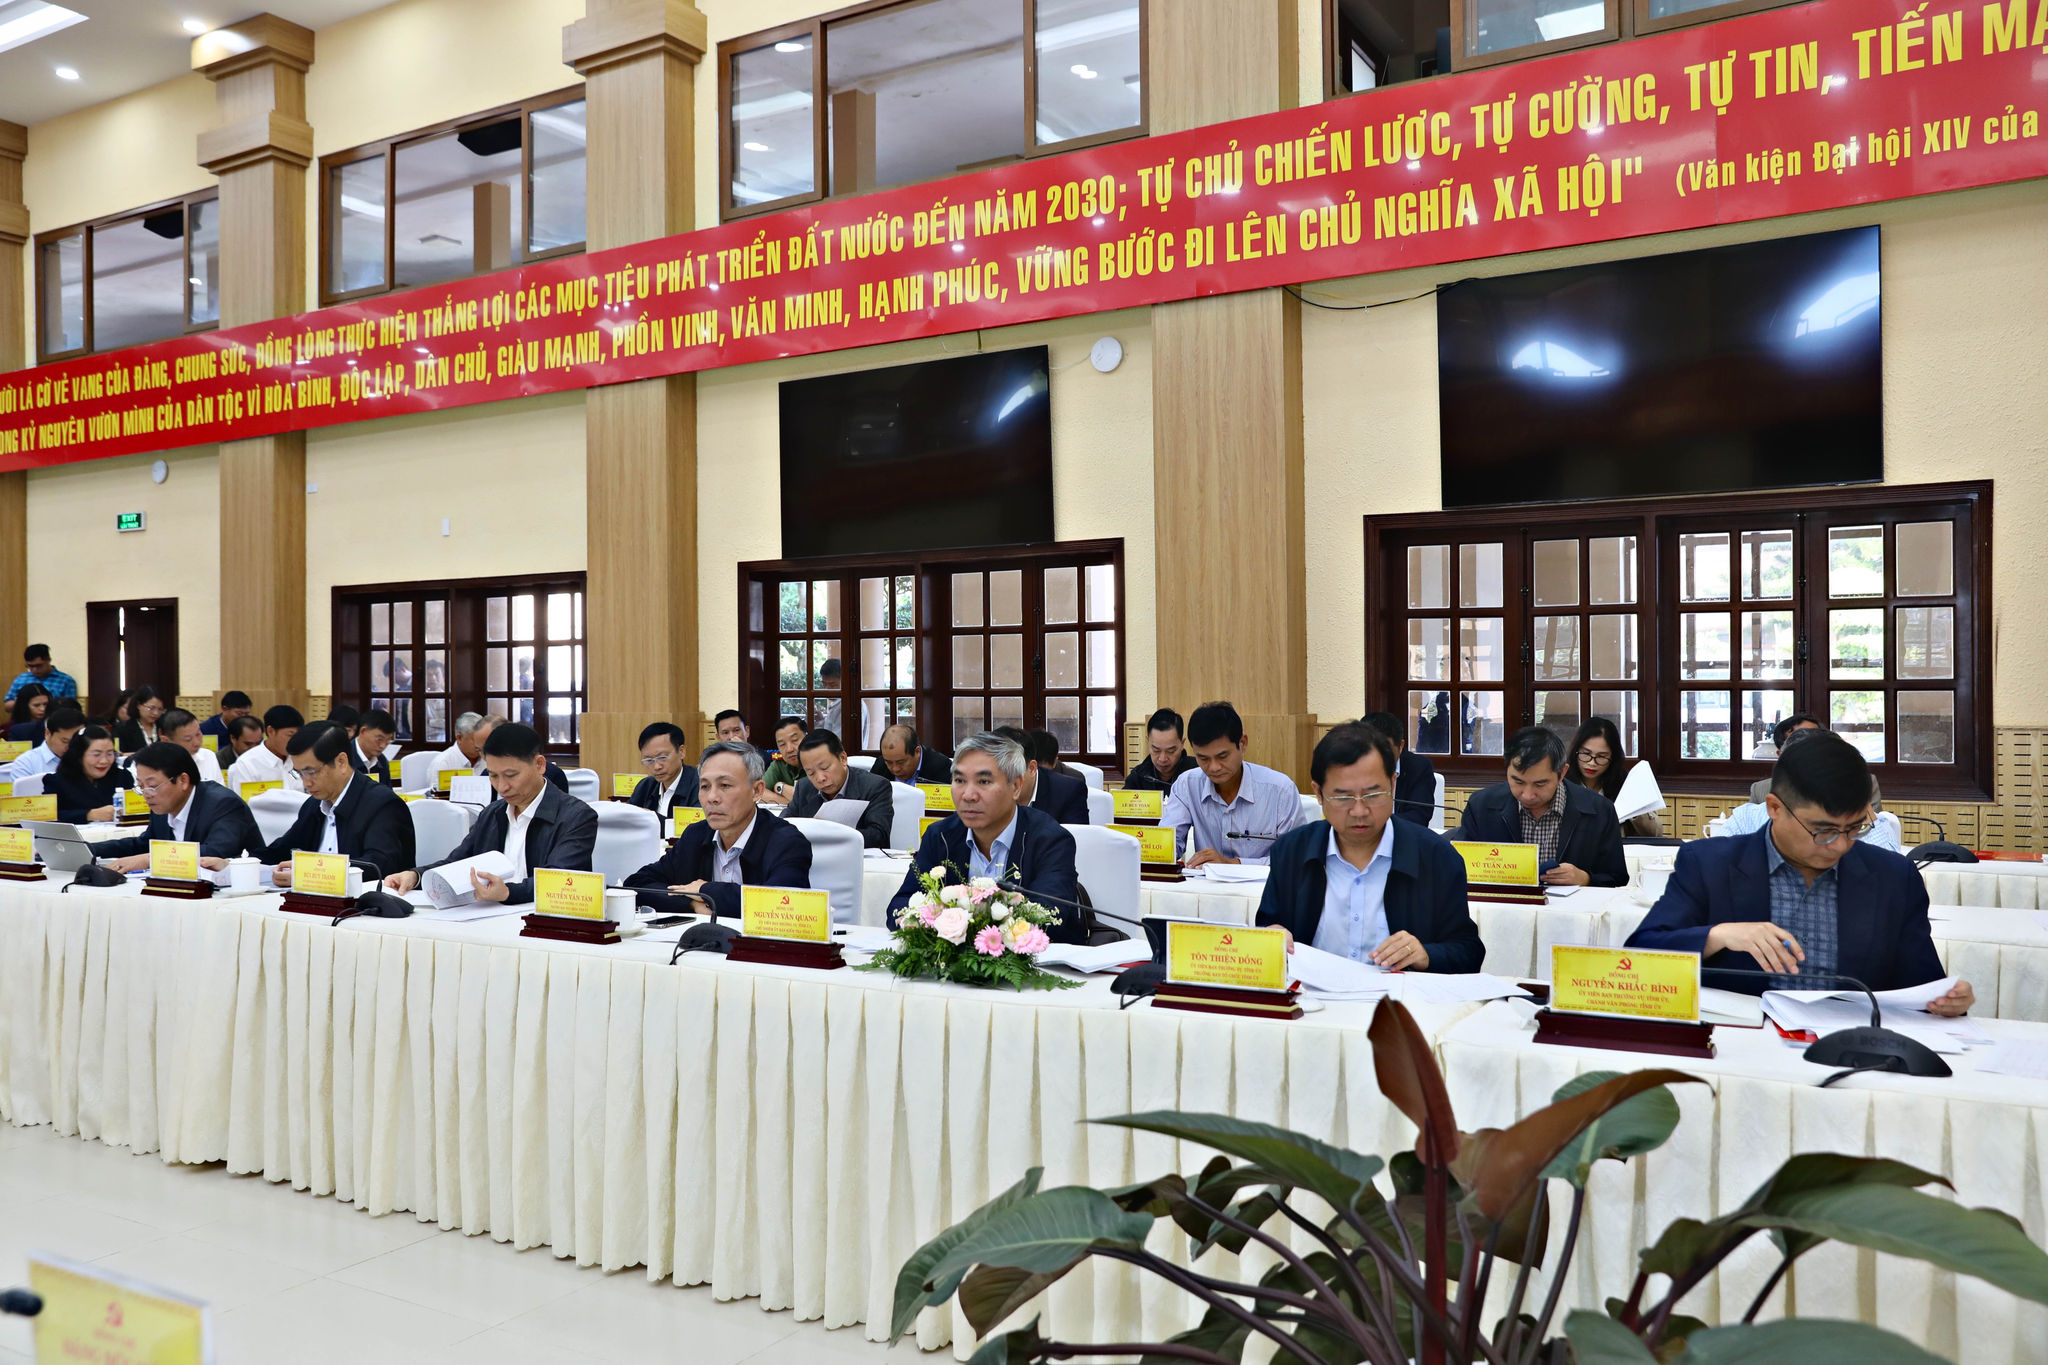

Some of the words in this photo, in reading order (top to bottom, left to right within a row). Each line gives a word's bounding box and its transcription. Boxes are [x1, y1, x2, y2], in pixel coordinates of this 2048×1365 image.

[1676, 160, 1735, 196] (Văn
[1746, 148, 1801, 184] kiện
[1869, 127, 1911, 166] hội
[1924, 116, 1971, 154] XIV
[1984, 105, 2038, 144] của
[20, 382, 33, 410] LÁ
[37, 377, 51, 407] CỜ
[54, 373, 68, 404] VẺ
[73, 373, 102, 401] VANG
[106, 363, 130, 396] CỦA
[134, 357, 171, 391] ĐẢNG,
[176, 352, 216, 384] CHUNG
[221, 343, 251, 375] SỨC,
[256, 332, 292, 369] ĐỒNG
[297, 327, 334, 359] LÒNG
[337, 318, 375, 356] THỰC
[380, 309, 417, 348] HIỆN
[423, 294, 477, 338] THẮNG
[483, 291, 510, 331] LỢI
[515, 282, 551, 321] CÁC
[557, 276, 598, 316] MỤC
[605, 264, 649, 304] TIÊU
[656, 251, 709, 295] PHÁT
[717, 230, 780, 283] TRIỂN
[788, 221, 834, 270] ĐẤT
[841, 211, 904, 261] NƯỚC
[913, 197, 965, 248] ĐẾN
[975, 189, 1036, 236] NĂM
[1047, 175, 1126, 224] 2030;
[1138, 157, 1174, 212] TỰ
[1186, 140, 1243, 198] CHỦ
[1256, 122, 1351, 185] CHIẾN
[1365, 109, 1462, 169] LƯỢC,
[1470, 92, 1516, 153] TỰ
[1529, 74, 1670, 138] CƯỜNG,
[1684, 50, 1736, 115] TỰ
[1852, 2, 1962, 79] TIẾN
[22, 420, 35, 451] KỶ
[39, 416, 84, 448] NGUYÊN
[123, 405, 154, 436] MÌNH
[157, 397, 182, 430] CỦA
[187, 394, 213, 426] DÂN
[218, 389, 242, 424] TỘC
[247, 384, 260, 416] VÌ
[265, 380, 292, 413] HÒA
[298, 375, 336, 408] BÌNH,
[340, 367, 370, 405] ĐỘC
[375, 361, 409, 399] LẬP,
[416, 357, 449, 389] DÂN
[454, 342, 492, 384] CHỦ,
[497, 338, 539, 376] GIÀU
[545, 331, 606, 372] MẠNH,
[612, 312, 664, 358] PHỒN
[671, 310, 725, 348] VINH,
[731, 296, 776, 339] VĂN
[785, 288, 850, 331] MINH,
[860, 275, 923, 322] HẠNH
[934, 258, 1008, 307] PHÚC,
[1017, 246, 1088, 293] VỮNG
[1100, 227, 1174, 281] BƯỚC
[1185, 226, 1214, 267] ĐI
[1226, 211, 1286, 262] LÊN
[1300, 190, 1361, 250] CHỦ
[1374, 178, 1476, 239] NGHĨA
[1494, 164, 1543, 221] XÃ
[1558, 154, 1642, 216] HỘI"
[795, 914, 818, 922] QUANG
[1651, 982, 1678, 994] BÌNH
